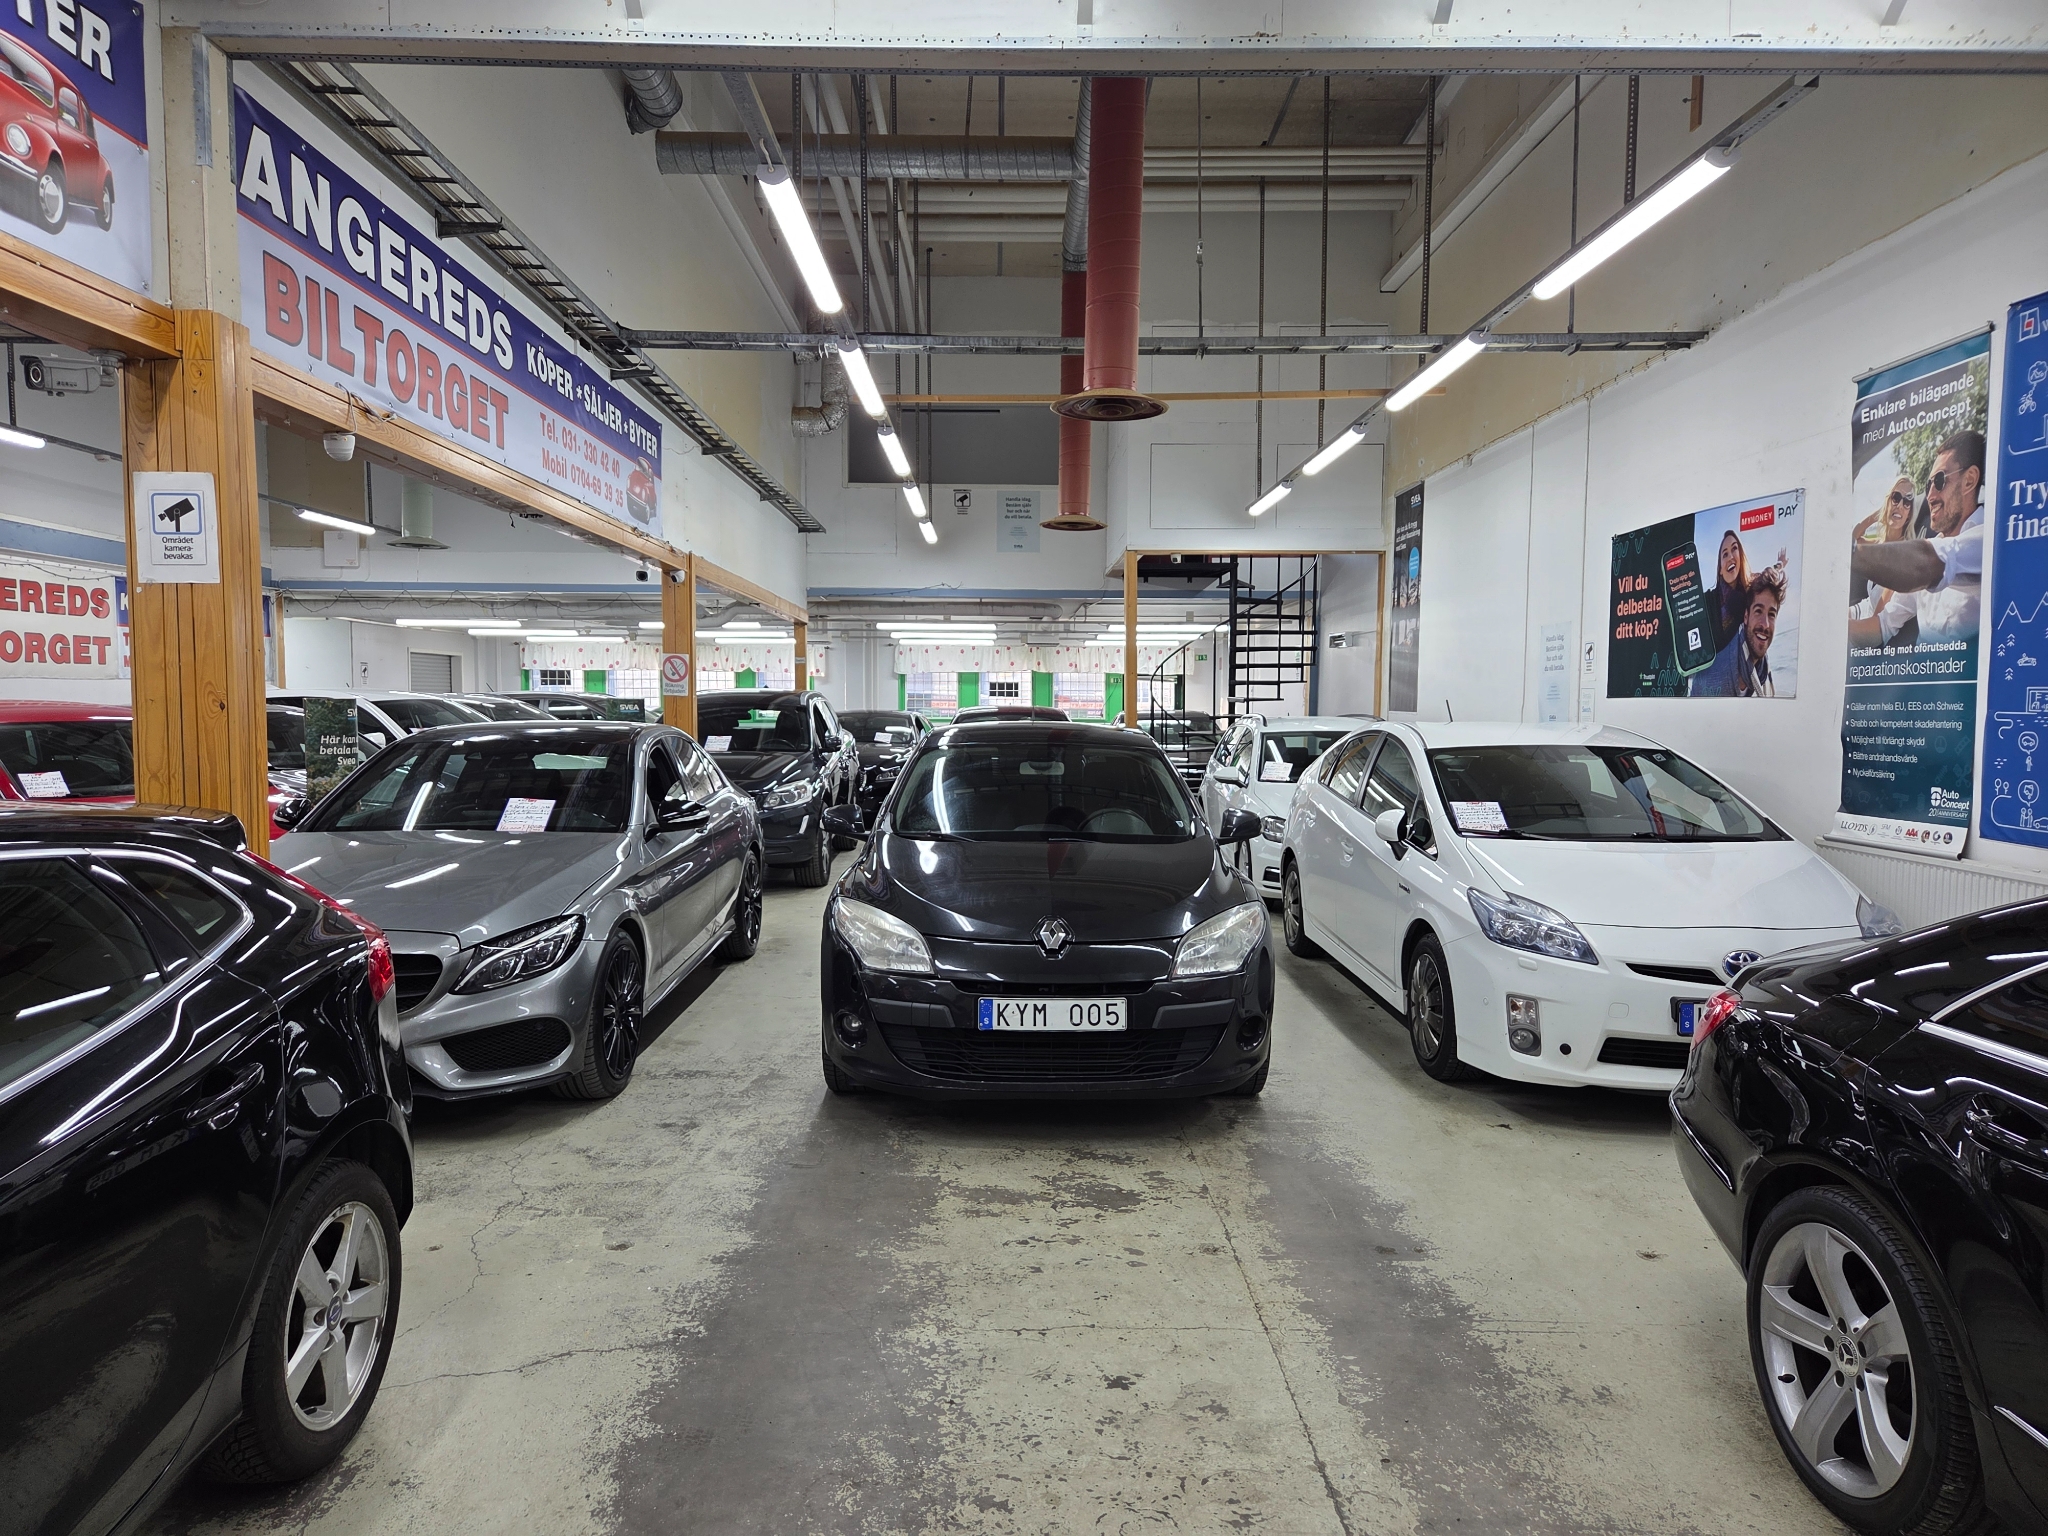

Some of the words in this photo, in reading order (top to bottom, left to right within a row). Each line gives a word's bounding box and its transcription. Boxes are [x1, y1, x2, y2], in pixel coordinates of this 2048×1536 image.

[239, 124, 514, 371] ANGEREDS
[263, 250, 509, 450] BILTORGET
[526, 343, 573, 401] KÖPER
[583, 383, 623, 435] SÄLJER
[629, 418, 658, 459] BYTER
[1861, 400, 1906, 423] Enklare
[1909, 374, 1975, 407] bilägande
[1863, 424, 1886, 444] med
[1887, 396, 1972, 436] AutoConcept
[539, 412, 559, 444] Tel.
[583, 440, 598, 466] 330
[601, 453, 610, 473] 42
[611, 457, 620, 479] 40
[542, 447, 568, 479] Mobil
[604, 481, 613, 503] 39
[615, 486, 624, 508] 35
[1778, 504, 1798, 519] PAY
[162, 536, 194, 544] Området
[164, 544, 194, 552] kamera-
[163, 552, 194, 560] bevakas
[1618, 575, 1633, 594] Vill
[1635, 573, 1648, 592] du
[1617, 595, 1662, 617] delbetala
[1616, 622, 1633, 640] ditt
[1635, 618, 1659, 640] köp?
[1850, 646, 1882, 658] Försäkra
[1883, 645, 1896, 657] dig
[1897, 643, 1913, 655] mot
[1914, 640, 1967, 653] oförutsedda
[1849, 656, 1967, 680] reparationskostnader
[1850, 702, 1867, 711] Gäller
[1867, 702, 1880, 711] inom
[1881, 702, 1894, 711] hela
[1895, 701, 1907, 713] EU,
[1908, 701, 1922, 711] EES
[1923, 701, 1936, 711] och
[1936, 701, 1964, 711] Schweiz
[1850, 719, 1868, 728] Snabb
[1868, 719, 1880, 728] och
[1880, 719, 1914, 730] kompetent
[1914, 719, 1963, 731] skadehantering
[321, 735, 340, 744] Här
[342, 735, 356, 744] kan
[1906, 737, 1926, 748] skydd
[320, 746, 351, 754] betala
[337, 757, 356, 766] Svea
[1853, 752, 1869, 761] Bättre
[1868, 752, 1918, 763] andrahandsvärde
[1853, 768, 1896, 781] Nyckelförsäkring
[1942, 788, 1960, 799] Auto
[1941, 798, 1970, 811] Concept
[1841, 821, 1868, 833] LLOYDS
[984, 1017, 990, 1025] S
[997, 1003, 1048, 1027] KYM
[1069, 1003, 1120, 1027] 005
[1684, 1021, 1690, 1029] S
